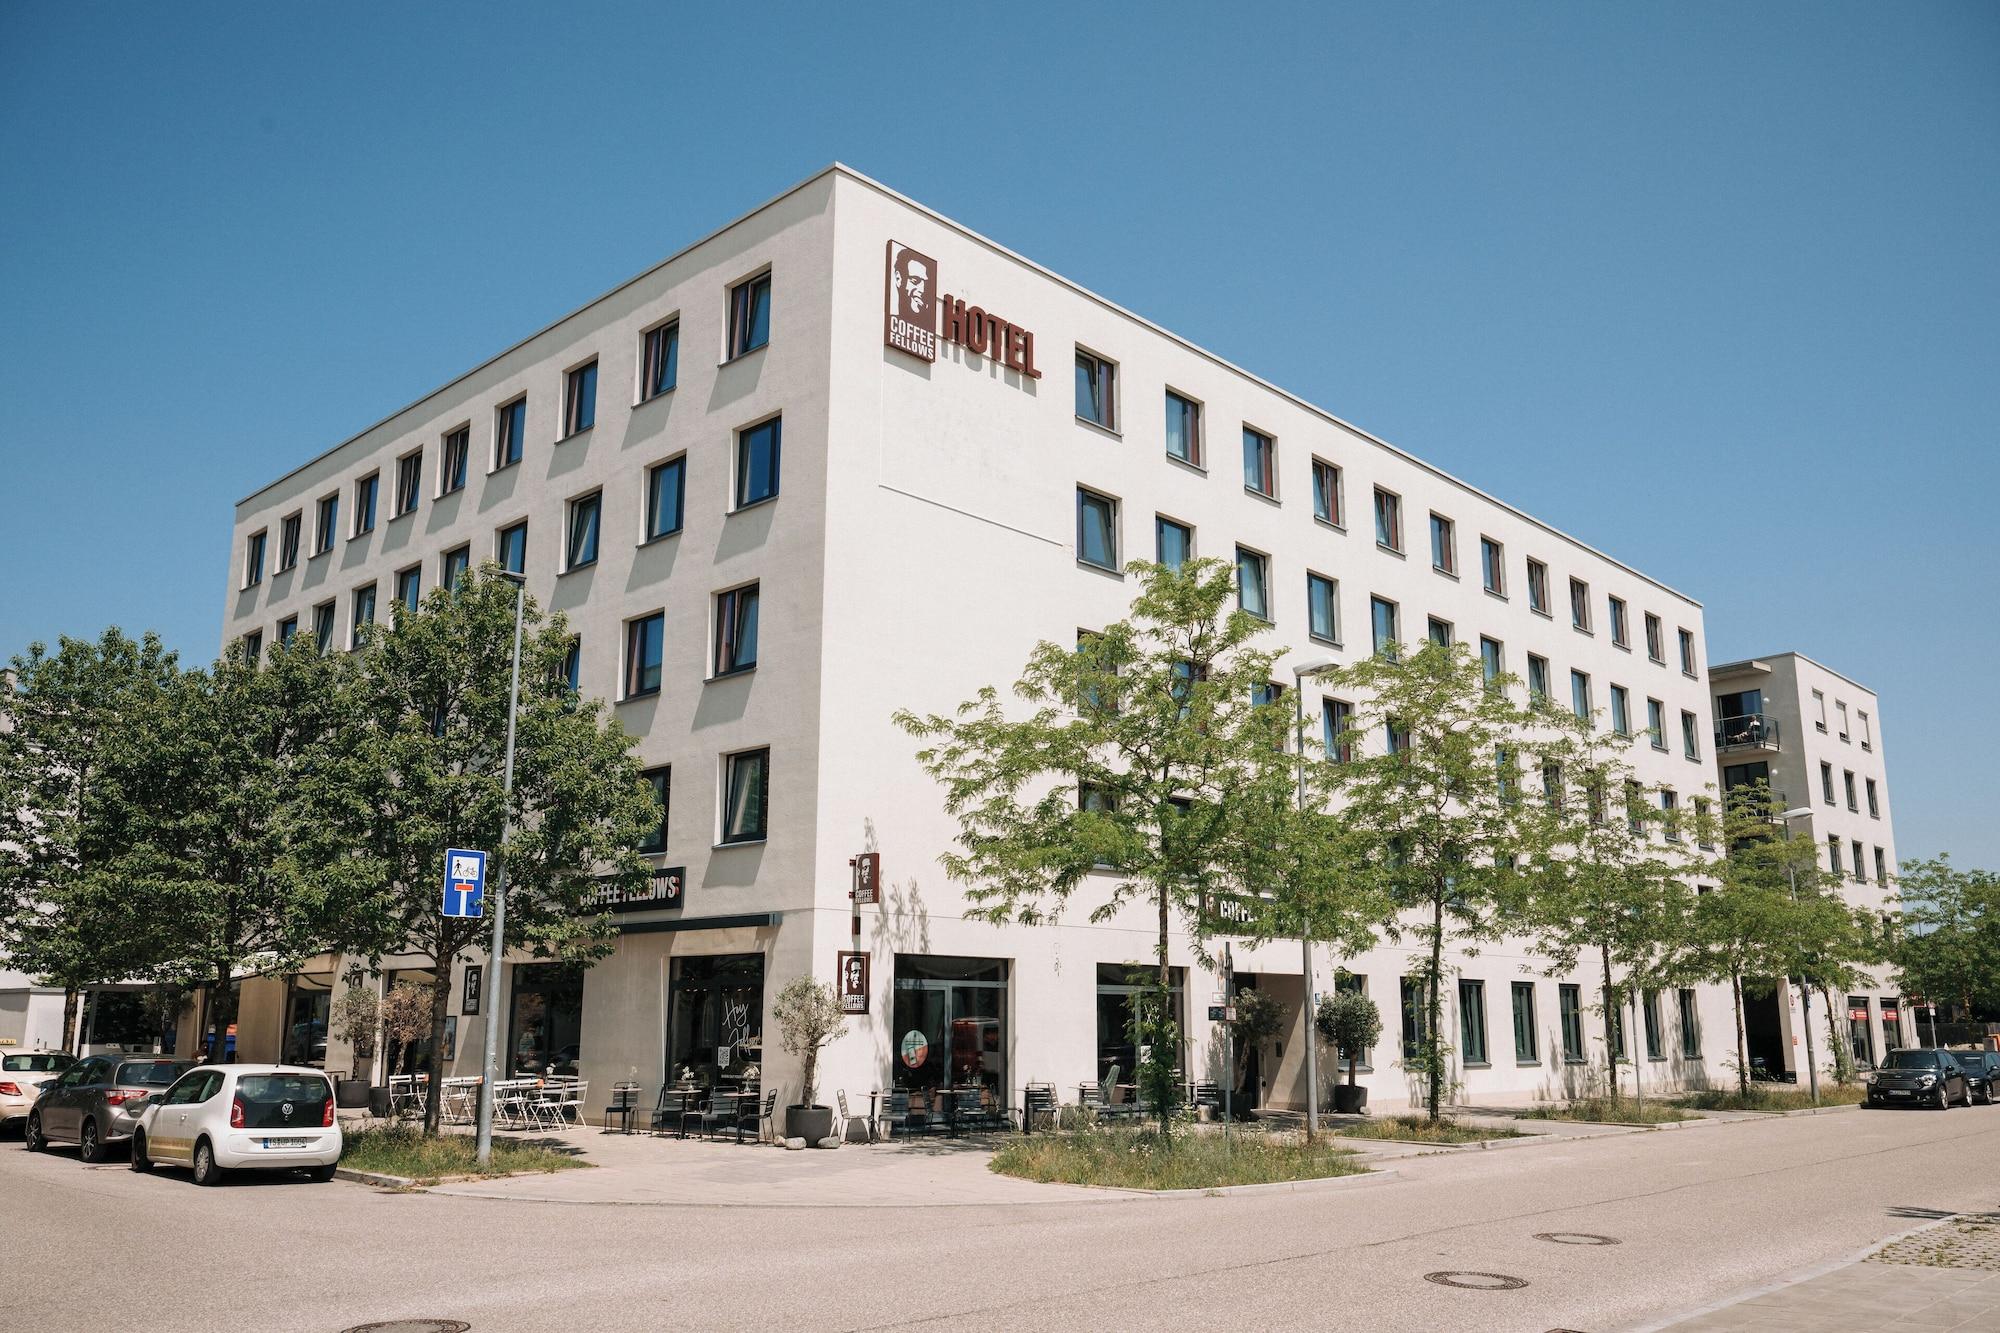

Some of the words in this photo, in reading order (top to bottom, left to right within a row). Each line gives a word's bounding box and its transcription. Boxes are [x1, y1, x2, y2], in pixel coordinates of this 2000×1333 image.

[890, 316, 934, 348] COFFEE
[890, 331, 934, 360] FELLOWS
[943, 293, 1042, 379] HOTEL
[855, 889, 873, 899] COFFEE
[1220, 900, 1259, 921] COFF
[843, 995, 865, 1003] COFFEE
[722, 999, 749, 1029] Hey
